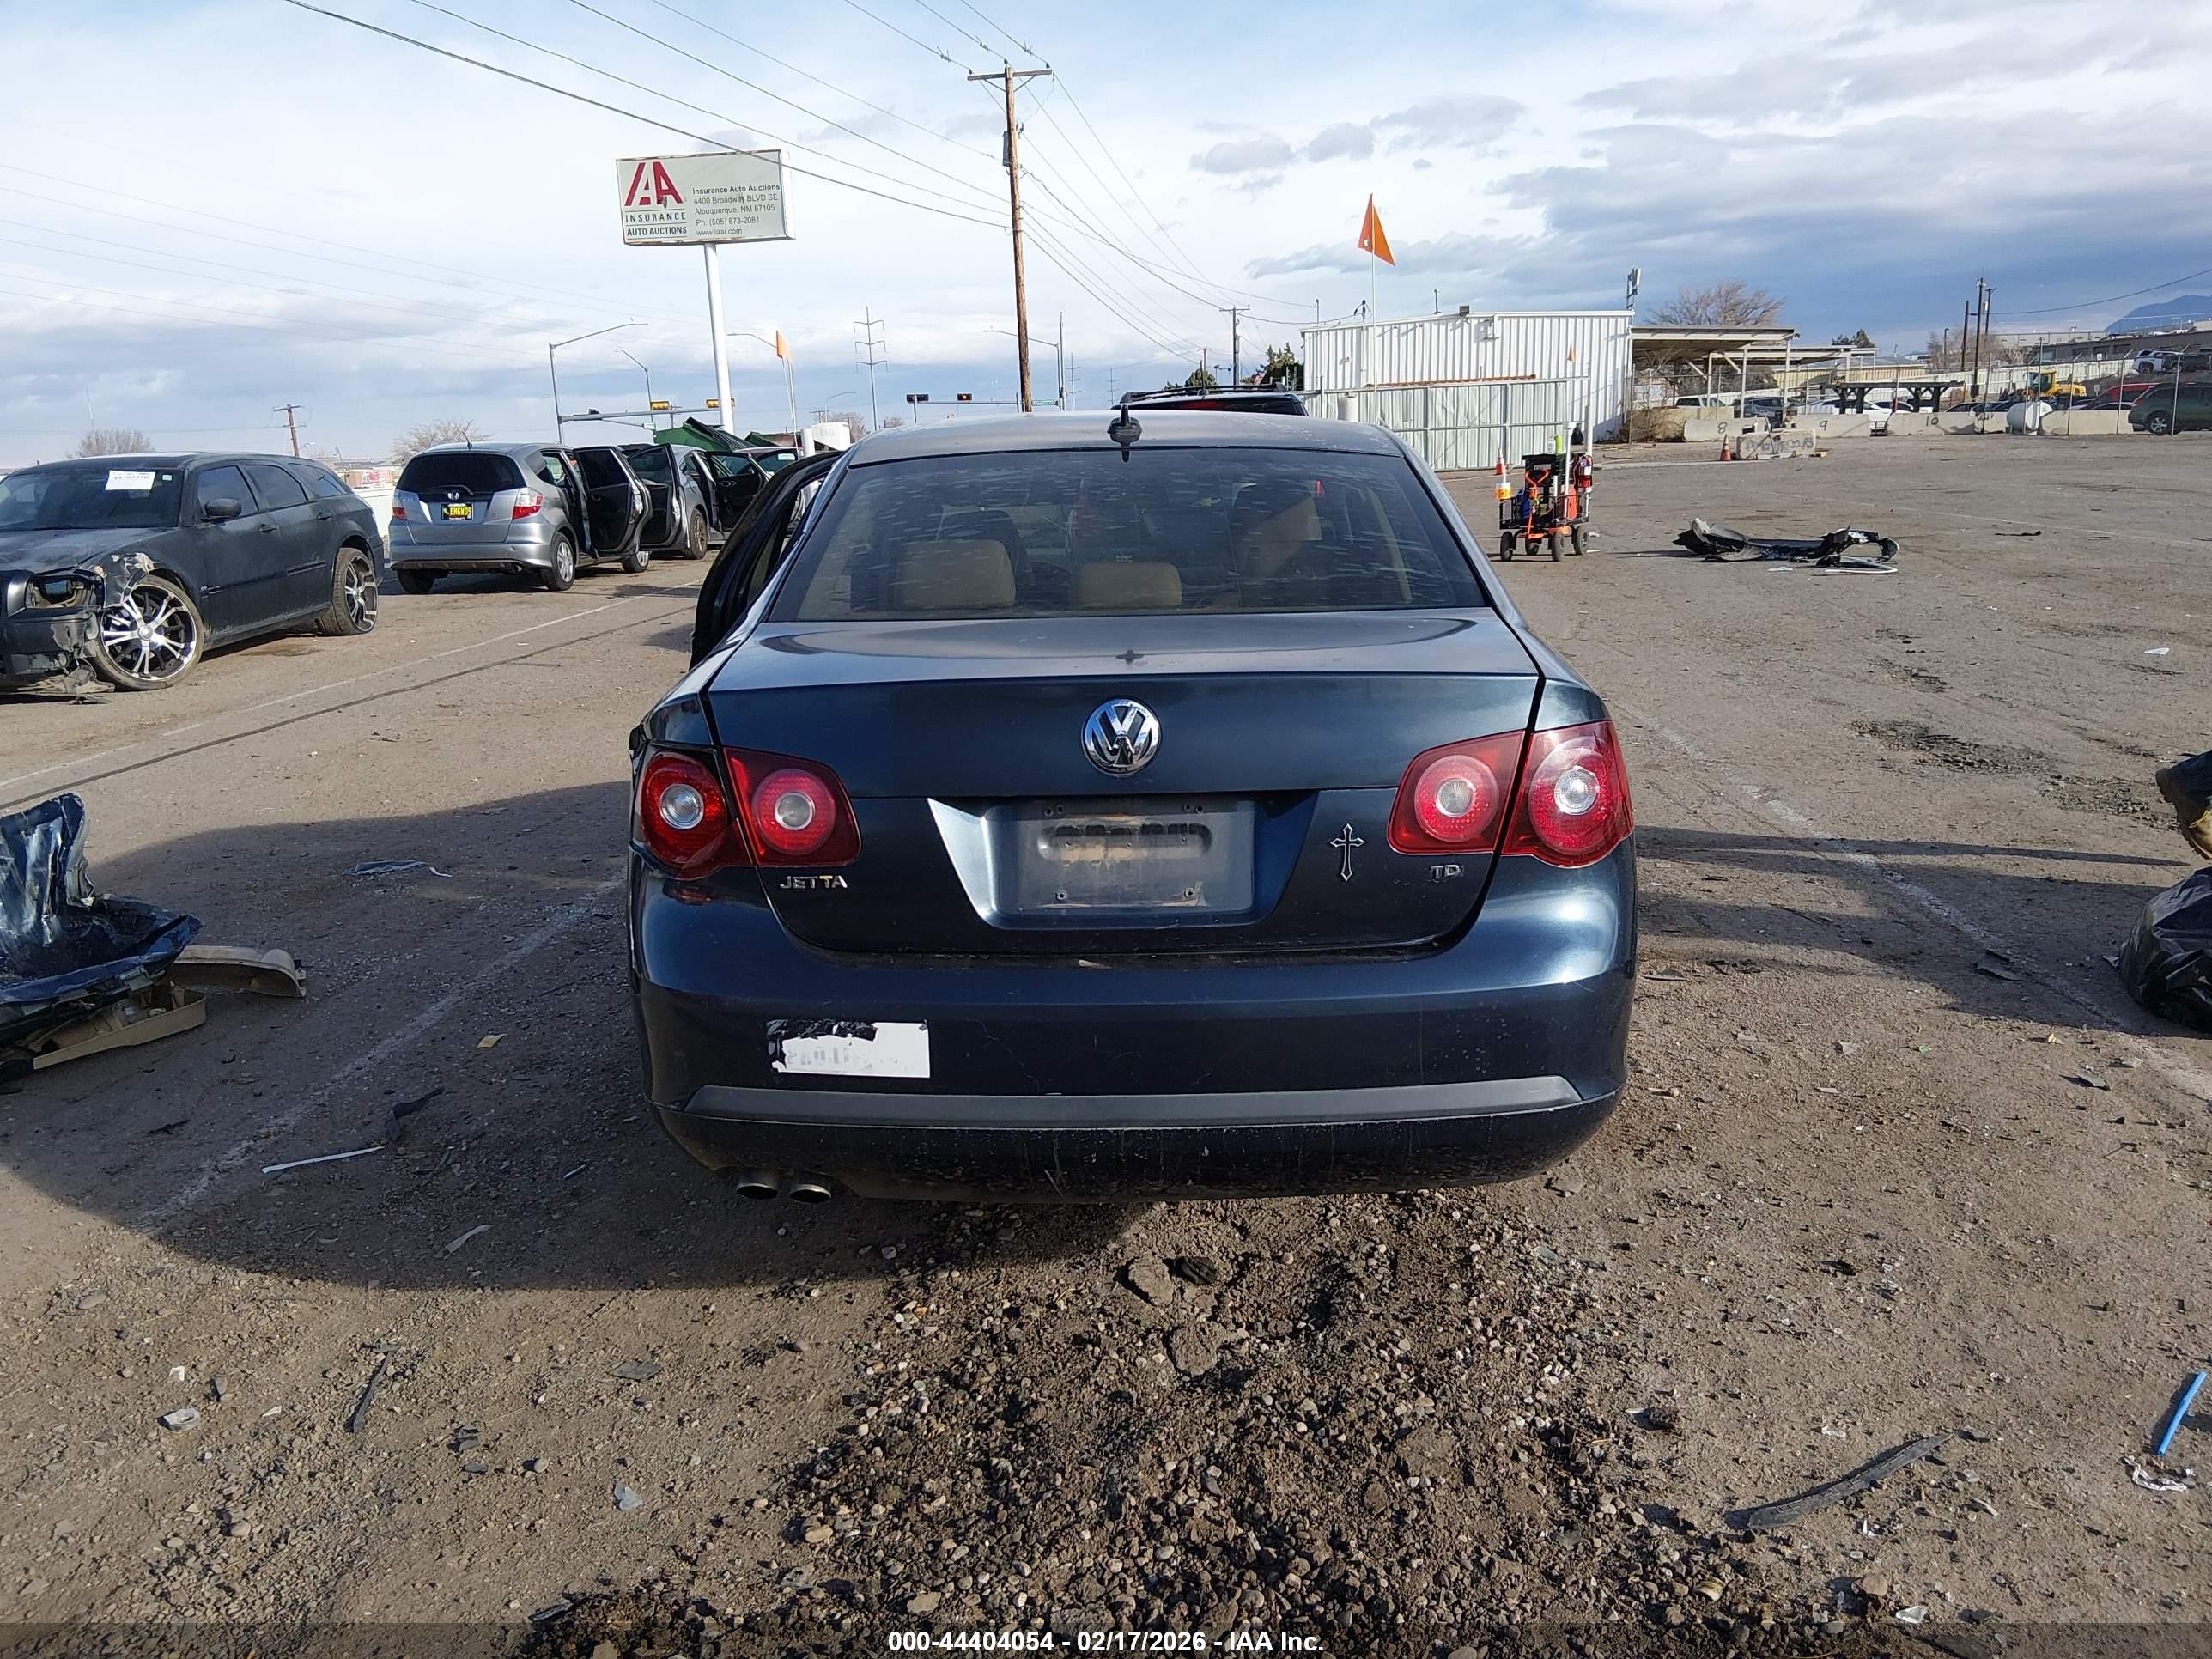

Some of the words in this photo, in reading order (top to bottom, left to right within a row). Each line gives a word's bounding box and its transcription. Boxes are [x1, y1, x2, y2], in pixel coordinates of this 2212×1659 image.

[624, 161, 684, 207] IAA
[712, 195, 745, 205] Broadway
[746, 194, 766, 203] BLVD
[695, 206, 739, 216] Albuquerque,
[625, 212, 686, 223] INSURANCE
[709, 217, 726, 227] (505)
[728, 216, 760, 225] 873-2081
[627, 227, 647, 237] AUTO
[649, 226, 687, 236] AUCTIONS
[696, 228, 743, 236] www.iaai.com
[1820, 420, 1828, 431] 9
[1925, 415, 1939, 427] 10
[1717, 421, 1728, 434] 8
[780, 875, 848, 889] JETTA
